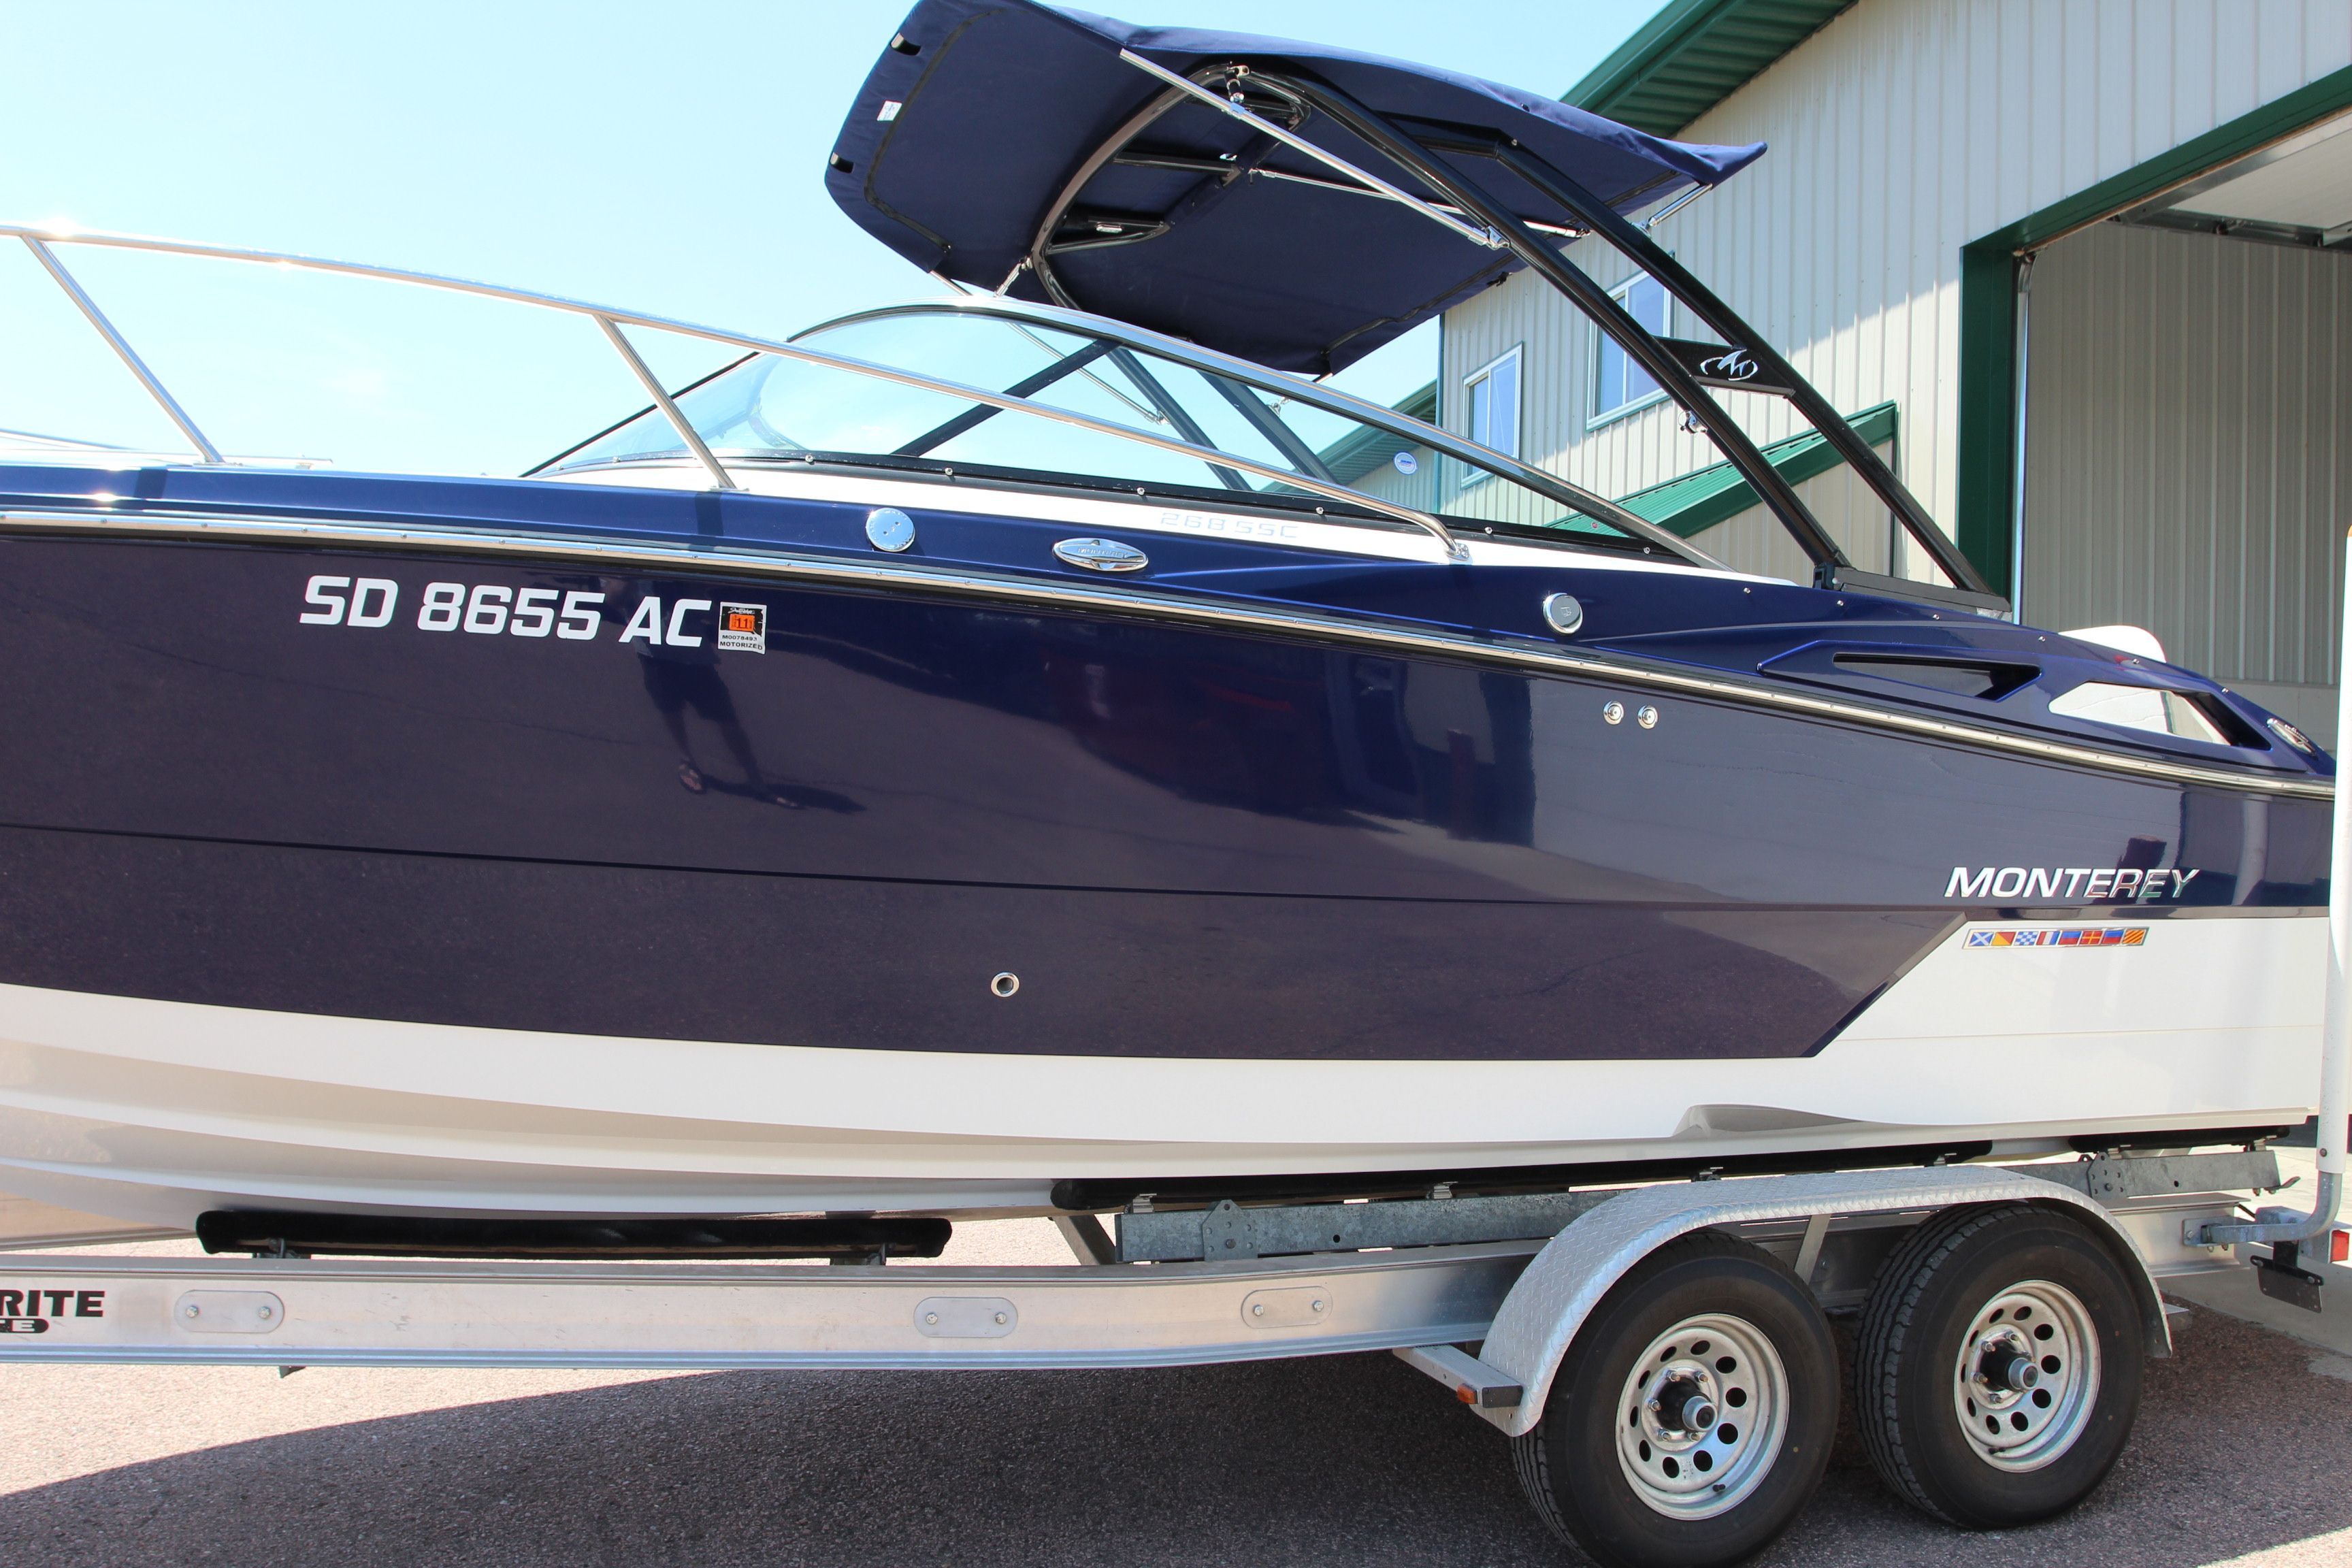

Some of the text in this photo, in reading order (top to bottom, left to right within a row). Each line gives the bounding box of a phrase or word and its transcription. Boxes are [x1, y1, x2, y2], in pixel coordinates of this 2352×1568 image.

[299, 575, 712, 647] SD 8655 AC
[719, 641, 763, 651] MOTORIZED
[1944, 866, 2200, 898] MONTEREY
[0, 1290, 105, 1317] RITE
